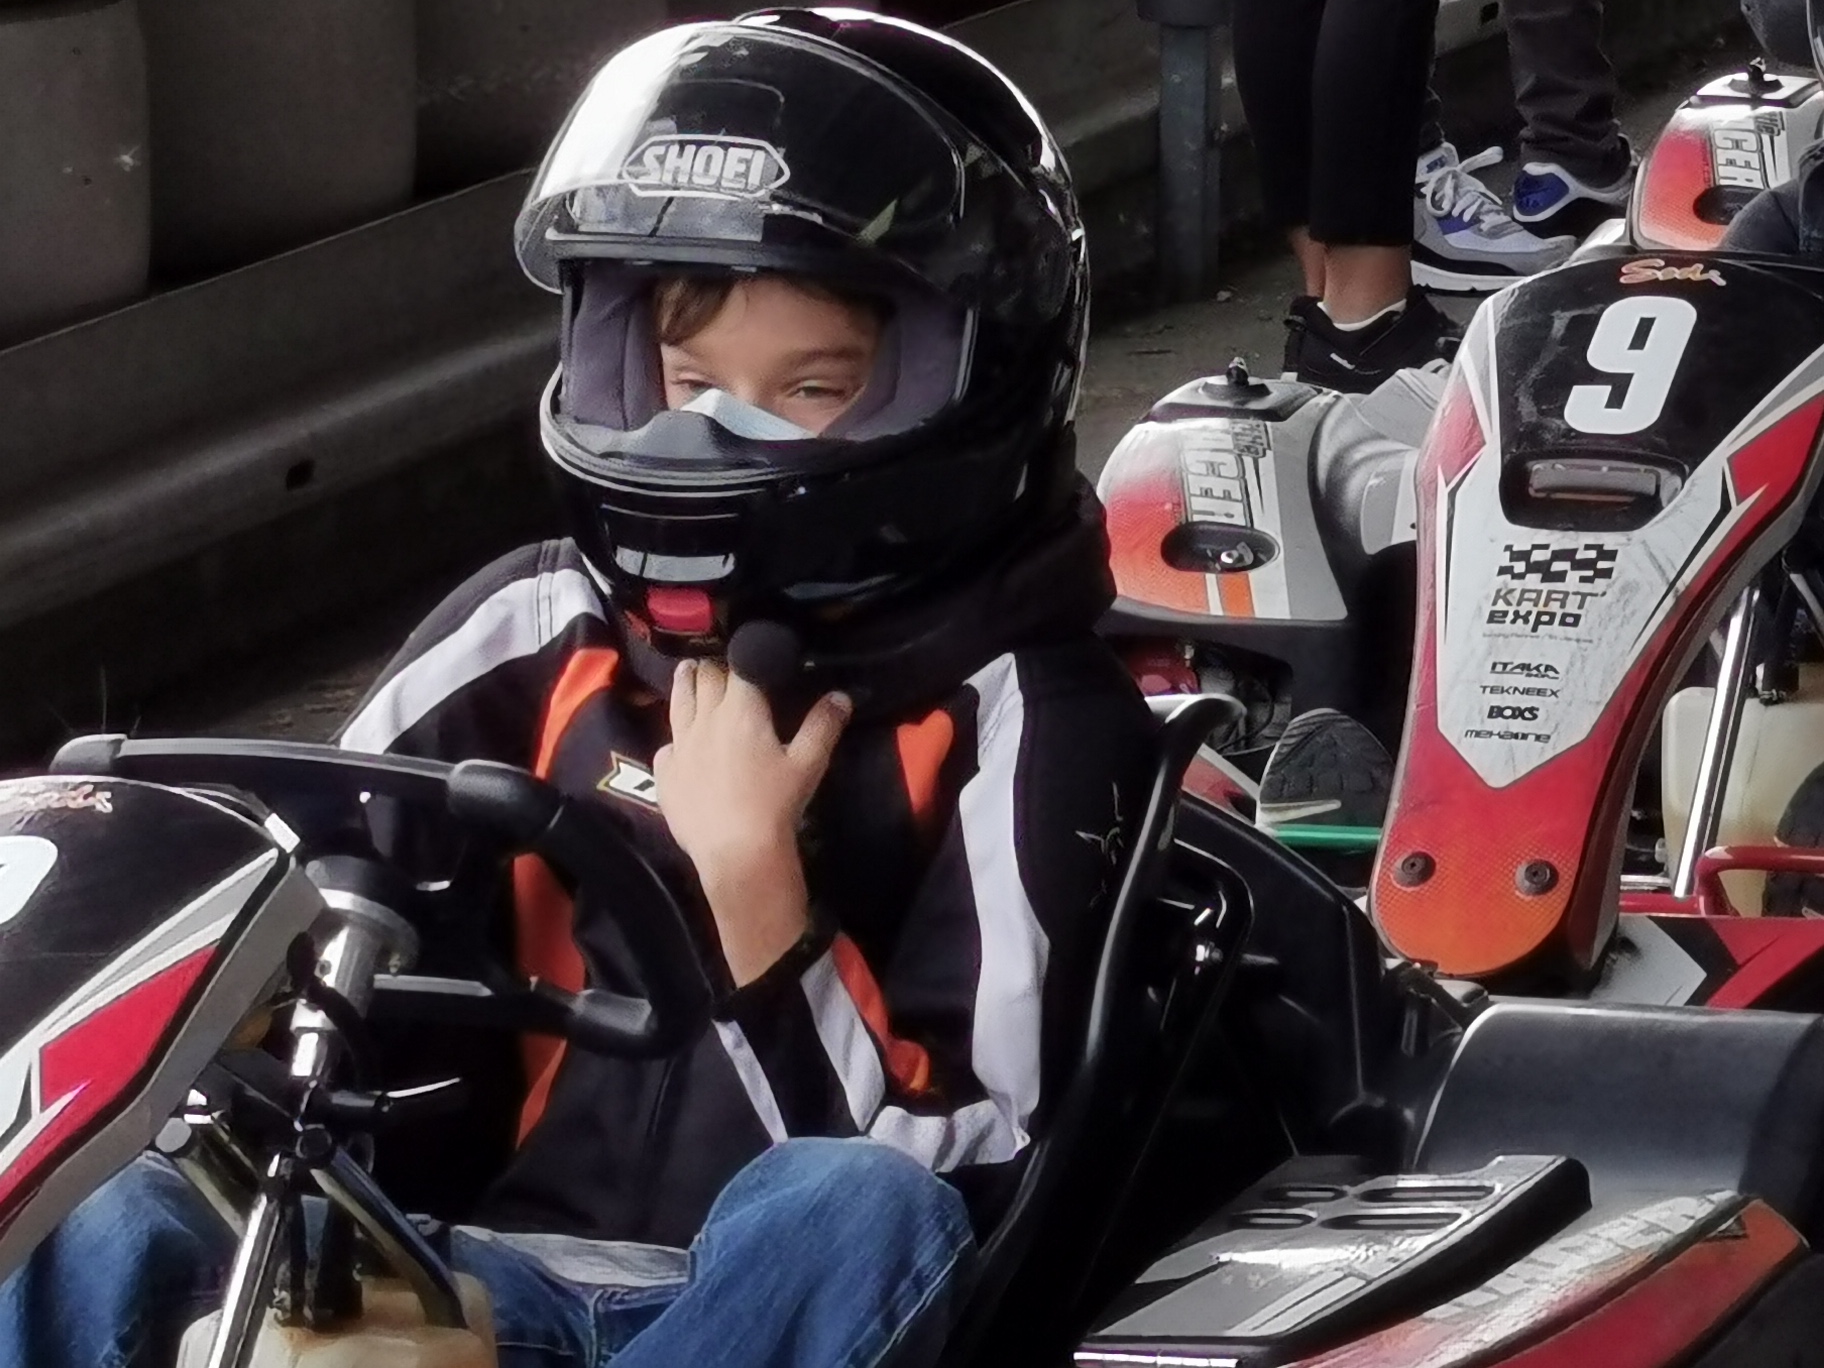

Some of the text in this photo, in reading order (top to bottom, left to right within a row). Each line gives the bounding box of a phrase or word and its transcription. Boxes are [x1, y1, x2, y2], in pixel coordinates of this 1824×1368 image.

[639, 143, 766, 190] SHOEI
[1564, 295, 1697, 435] 9
[1486, 610, 1581, 633] expo
[1490, 661, 1560, 674] ITAKA
[1480, 685, 1561, 699] TEKNEEX
